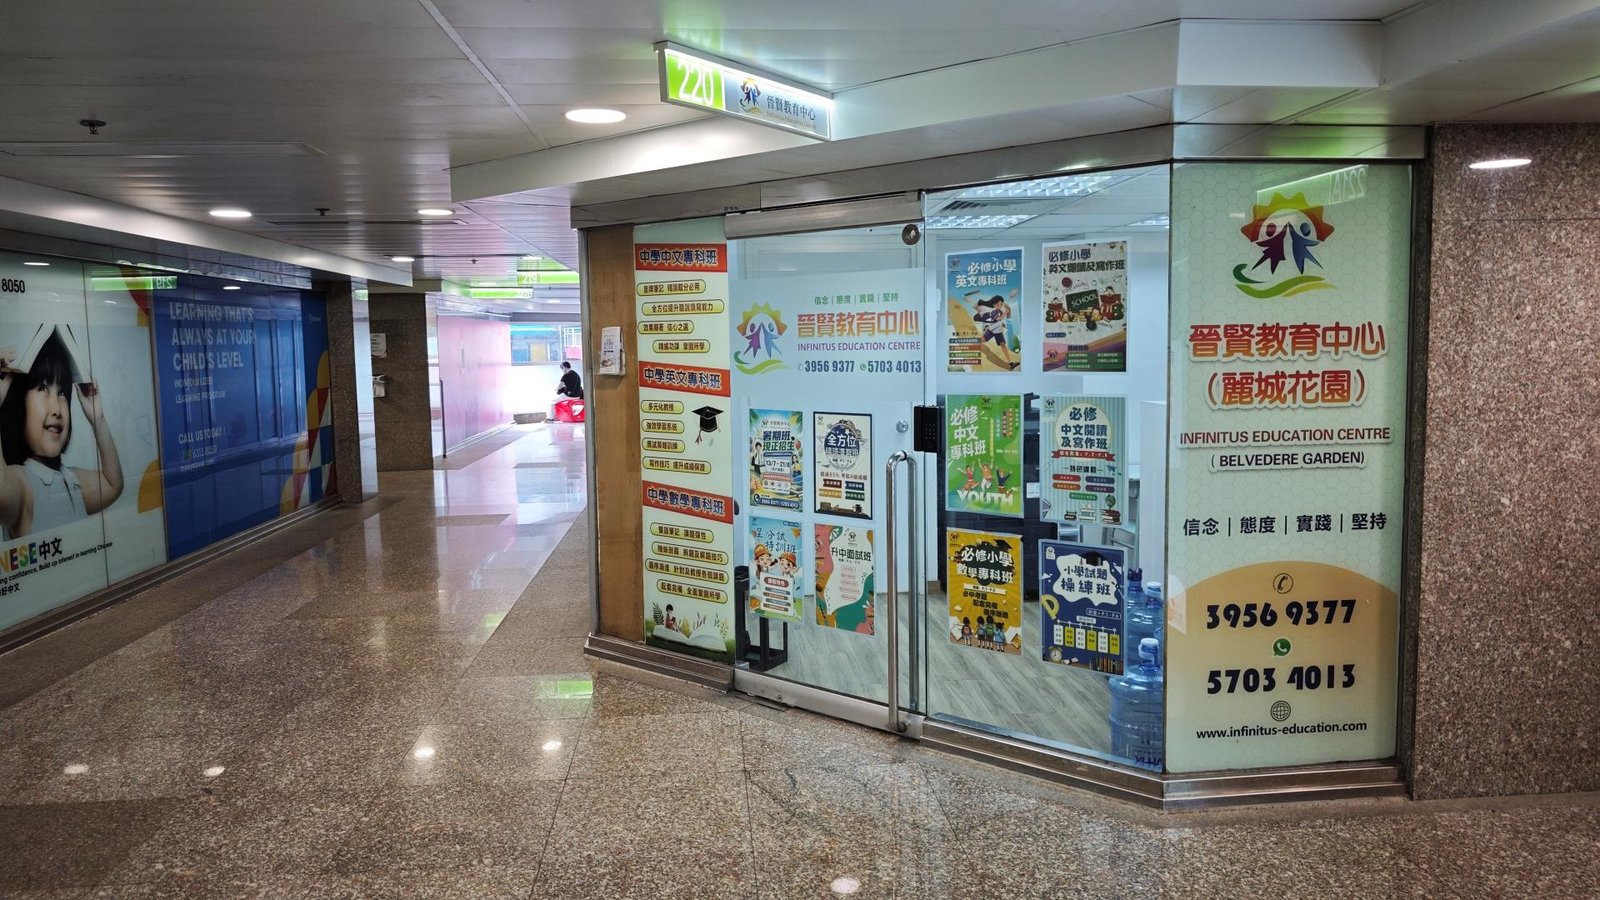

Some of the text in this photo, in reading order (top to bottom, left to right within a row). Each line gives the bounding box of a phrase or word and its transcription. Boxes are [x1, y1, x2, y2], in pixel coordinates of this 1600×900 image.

[677, 60, 715, 106] 220
[767, 95, 816, 121] 晉賢教育中心
[640, 249, 717, 265] 中學中文專科班
[1049, 249, 1091, 262] 必修小學
[968, 259, 1017, 275] 必修小學
[1049, 260, 1125, 274] 英文閱讀及寫作班
[1, 278, 26, 293] 8050
[956, 274, 1007, 287] 英文專科班
[814, 292, 899, 305] 信念 態度 實踐 堅持
[1071, 294, 1097, 307] SCHOOL
[169, 302, 254, 322] LEARNING THAT'S
[797, 309, 920, 338] 晉賢教育中心
[172, 328, 213, 346] ALWAYS
[216, 329, 228, 345] AT
[1189, 321, 1386, 358] 晉賢教育中心
[797, 341, 921, 351] INFINITUS EDUCATION CENTRE
[173, 352, 244, 371] CHILD'S LEVEL
[805, 360, 922, 373] 3956 9377 5703 4013
[644, 367, 721, 389] 中學英文專科班
[951, 406, 978, 426] 必修
[1069, 407, 1097, 421] 必修
[179, 432, 194, 444] CALL
[195, 430, 203, 440] US
[763, 431, 791, 440] 暑期班
[954, 425, 978, 442] 中文
[1061, 424, 1108, 436] 中文閱讀
[1180, 427, 1390, 445] INFINITUS EDUCATION CENTRE
[763, 441, 795, 451] 現正招生
[827, 434, 857, 446] 全方位
[1061, 437, 1108, 449] 及寫作班
[950, 440, 986, 459] 專科班
[1302, 451, 1365, 465] GARDEN)
[648, 488, 724, 514] 中學數學專科班
[957, 490, 1013, 504] YOUTH
[1183, 512, 1387, 536] 信念 態度 實踐 堅持
[39, 537, 63, 560] 中文
[765, 541, 797, 553] 特訓班
[831, 547, 871, 561] 升中面試班
[39, 562, 51, 571] Build
[59, 553, 74, 564] interest
[80, 546, 97, 557] learning
[962, 547, 1012, 567] 必修小學
[957, 564, 1013, 583] 數學專科班
[1064, 565, 1107, 580] 小學試題
[1061, 579, 1110, 595] 操練班
[1206, 599, 1357, 629] 3956 9377
[1207, 664, 1355, 694] 5703 4013
[1196, 721, 1367, 739] www.infinitus-education.com
